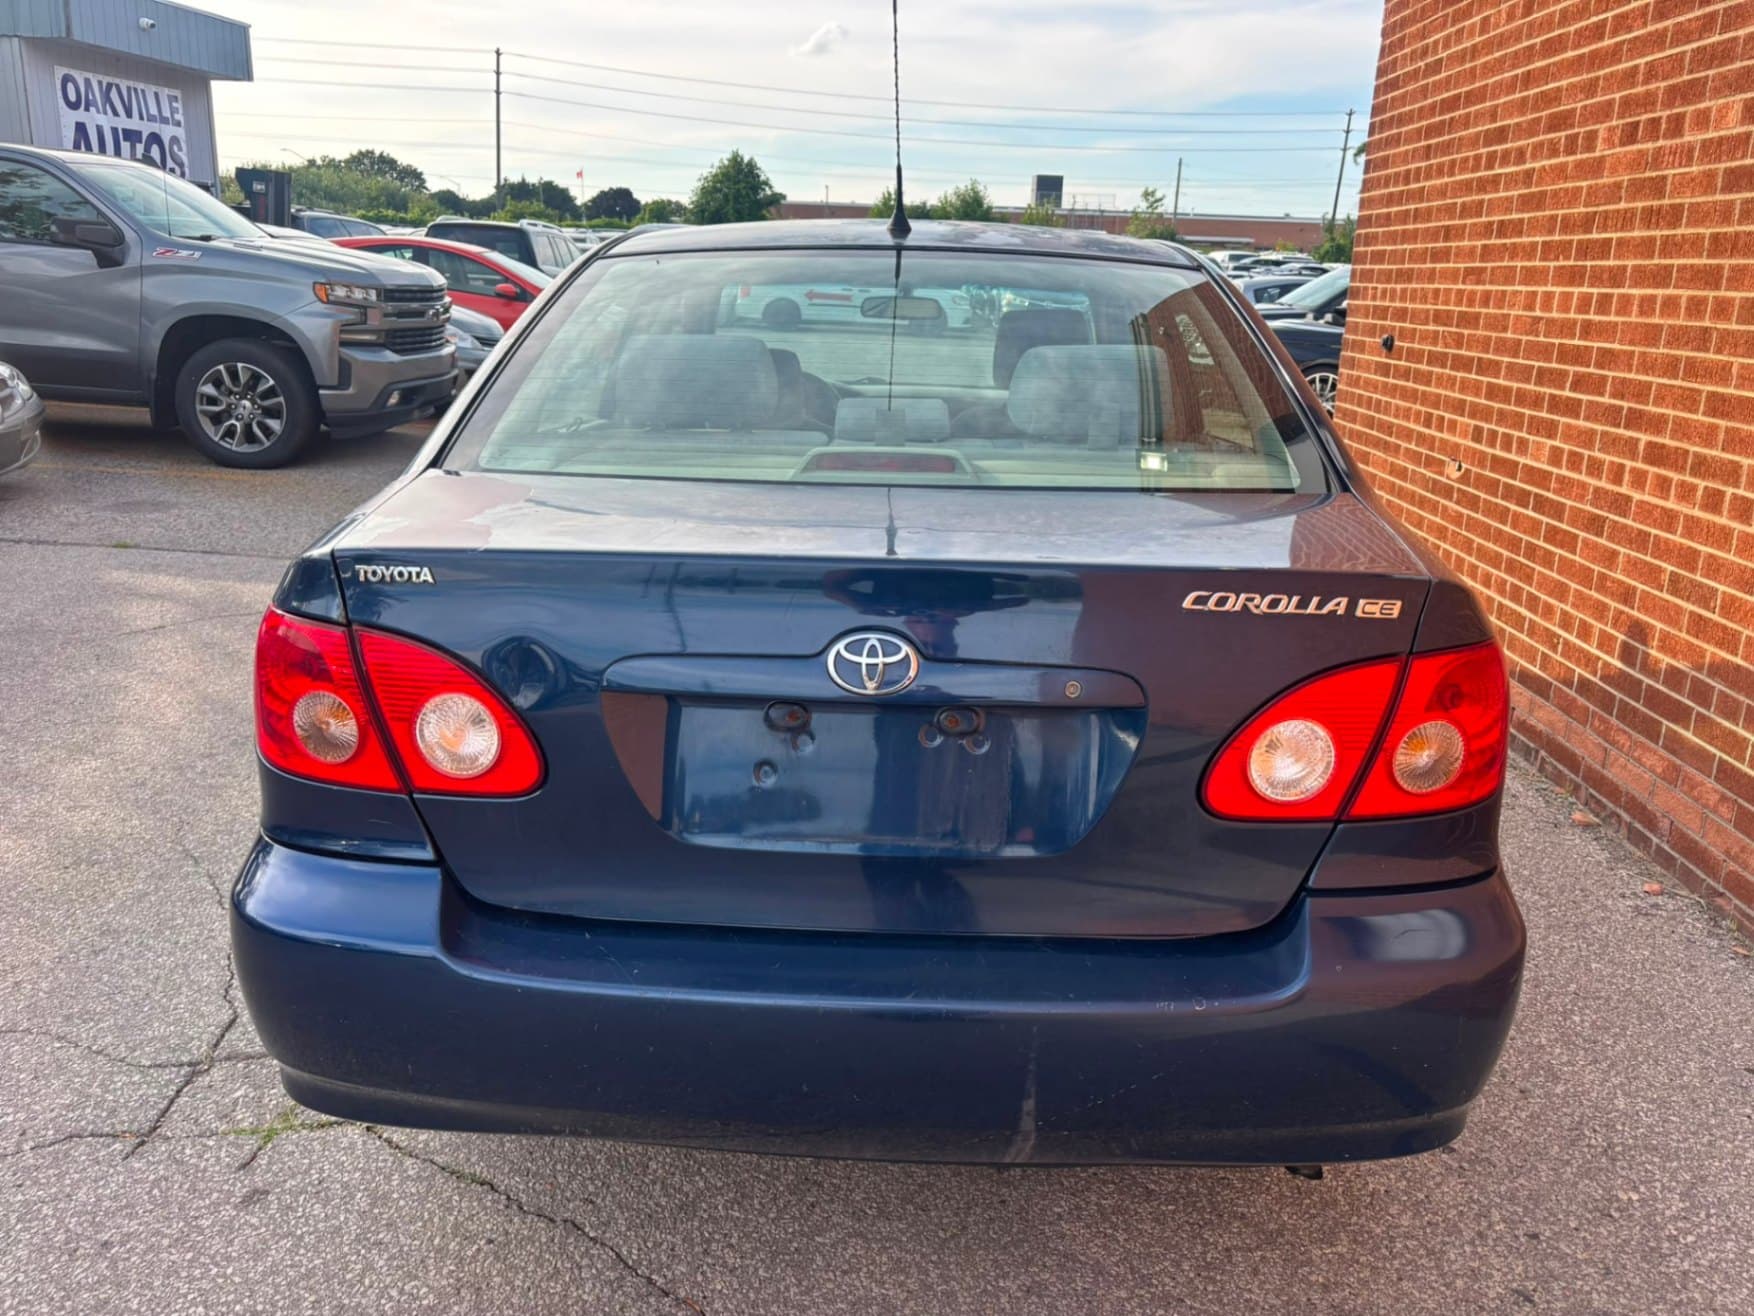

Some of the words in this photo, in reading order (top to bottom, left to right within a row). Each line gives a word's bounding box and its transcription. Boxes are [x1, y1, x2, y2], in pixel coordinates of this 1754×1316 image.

[61, 73, 182, 128] OAKVILLE
[72, 121, 186, 179] AUTOS
[355, 565, 435, 584] TOYOTA
[1182, 591, 1349, 615] COROLLA
[1358, 600, 1399, 618] CE
